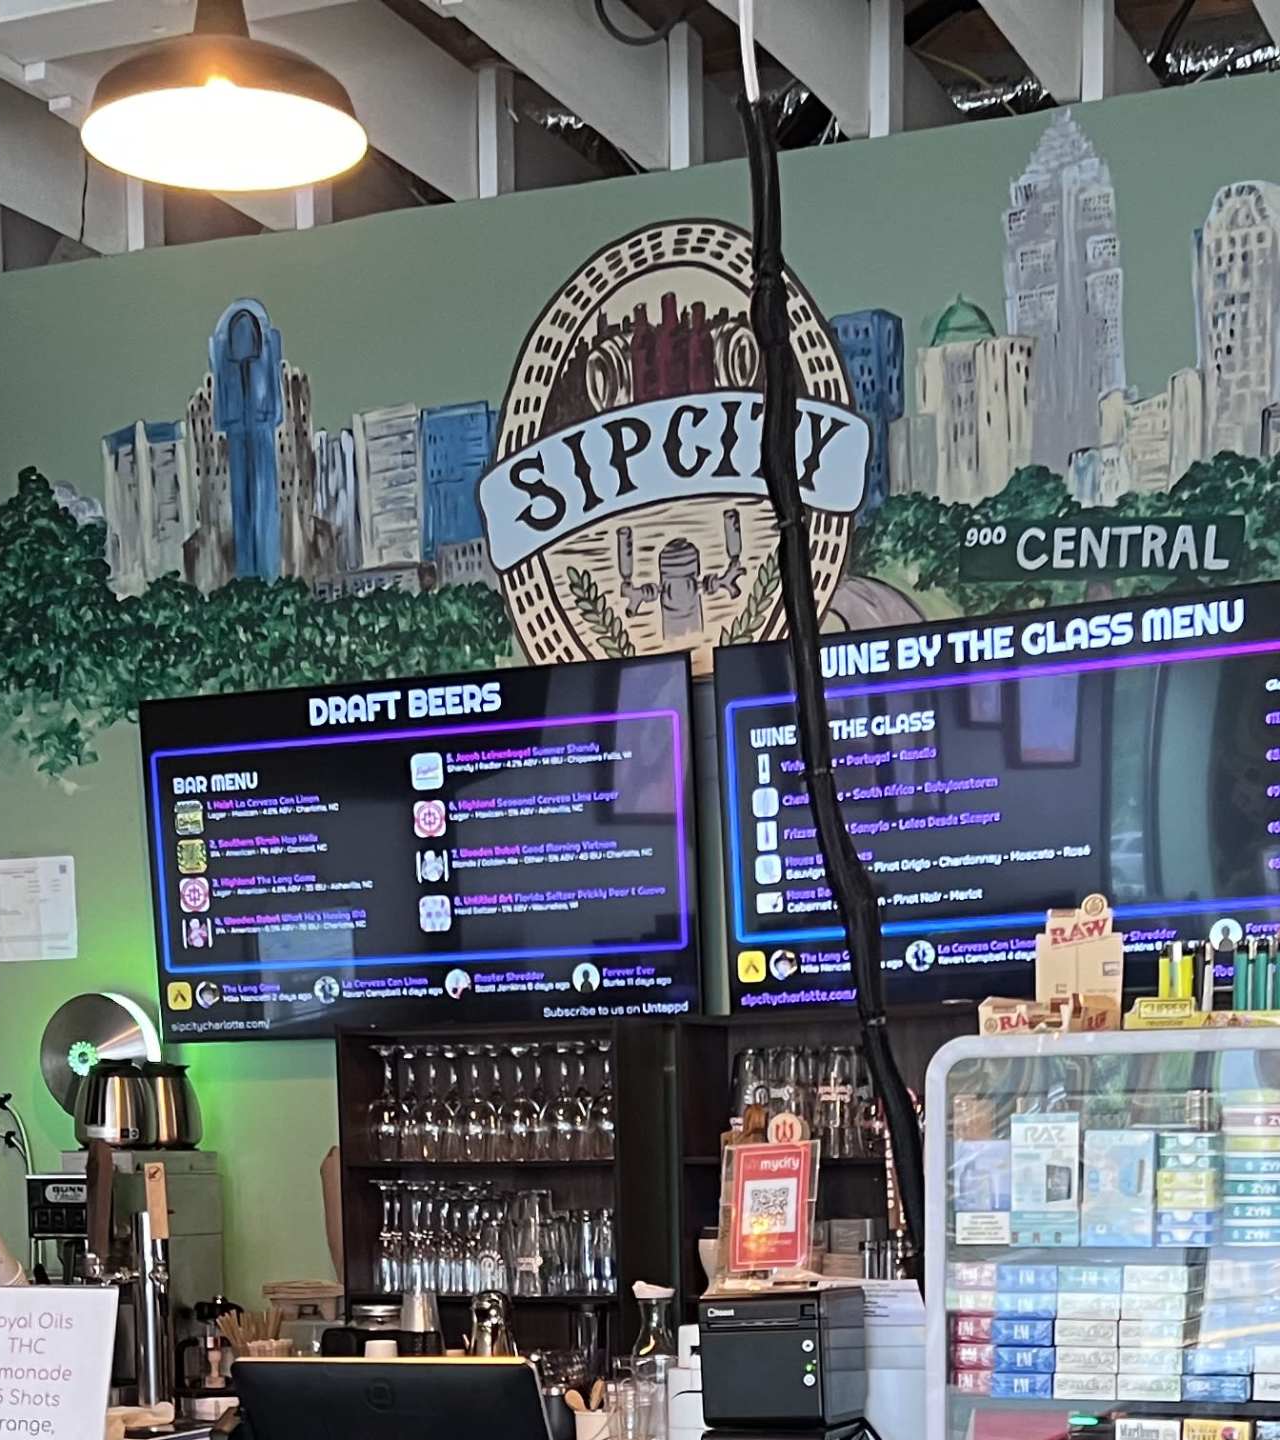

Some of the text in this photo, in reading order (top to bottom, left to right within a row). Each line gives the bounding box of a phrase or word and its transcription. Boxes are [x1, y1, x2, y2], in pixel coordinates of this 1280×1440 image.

[508, 400, 850, 533] SIPCIY
[965, 524, 1231, 571] 900 CENTRAL
[897, 634, 943, 670] BY
[948, 623, 1015, 664] THE
[1021, 611, 1134, 657] GLASS
[1141, 598, 1245, 643] MENU
[309, 682, 502, 727] DRAFT BEERS
[750, 710, 936, 749] WINE THE GLASS
[846, 751, 891, 767] Portugal
[173, 772, 258, 795] BAR MENU
[852, 787, 883, 800] South
[851, 822, 890, 837] Sangria
[938, 853, 1002, 868] Chardonnay
[1049, 916, 1110, 946] RAW
[543, 1006, 596, 1018] Subscribe
[597, 1005, 609, 1016] to
[610, 1005, 624, 1015] us
[641, 1000, 689, 1014] Untappd
[1251, 1182, 1277, 1195] ZYN
[1245, 1204, 1271, 1217] ZYN
[1244, 1229, 1270, 1241] ZYN
[37, 1312, 74, 1330] Oils
[7, 1337, 47, 1355] THC
[9, 1389, 61, 1408] Shots
